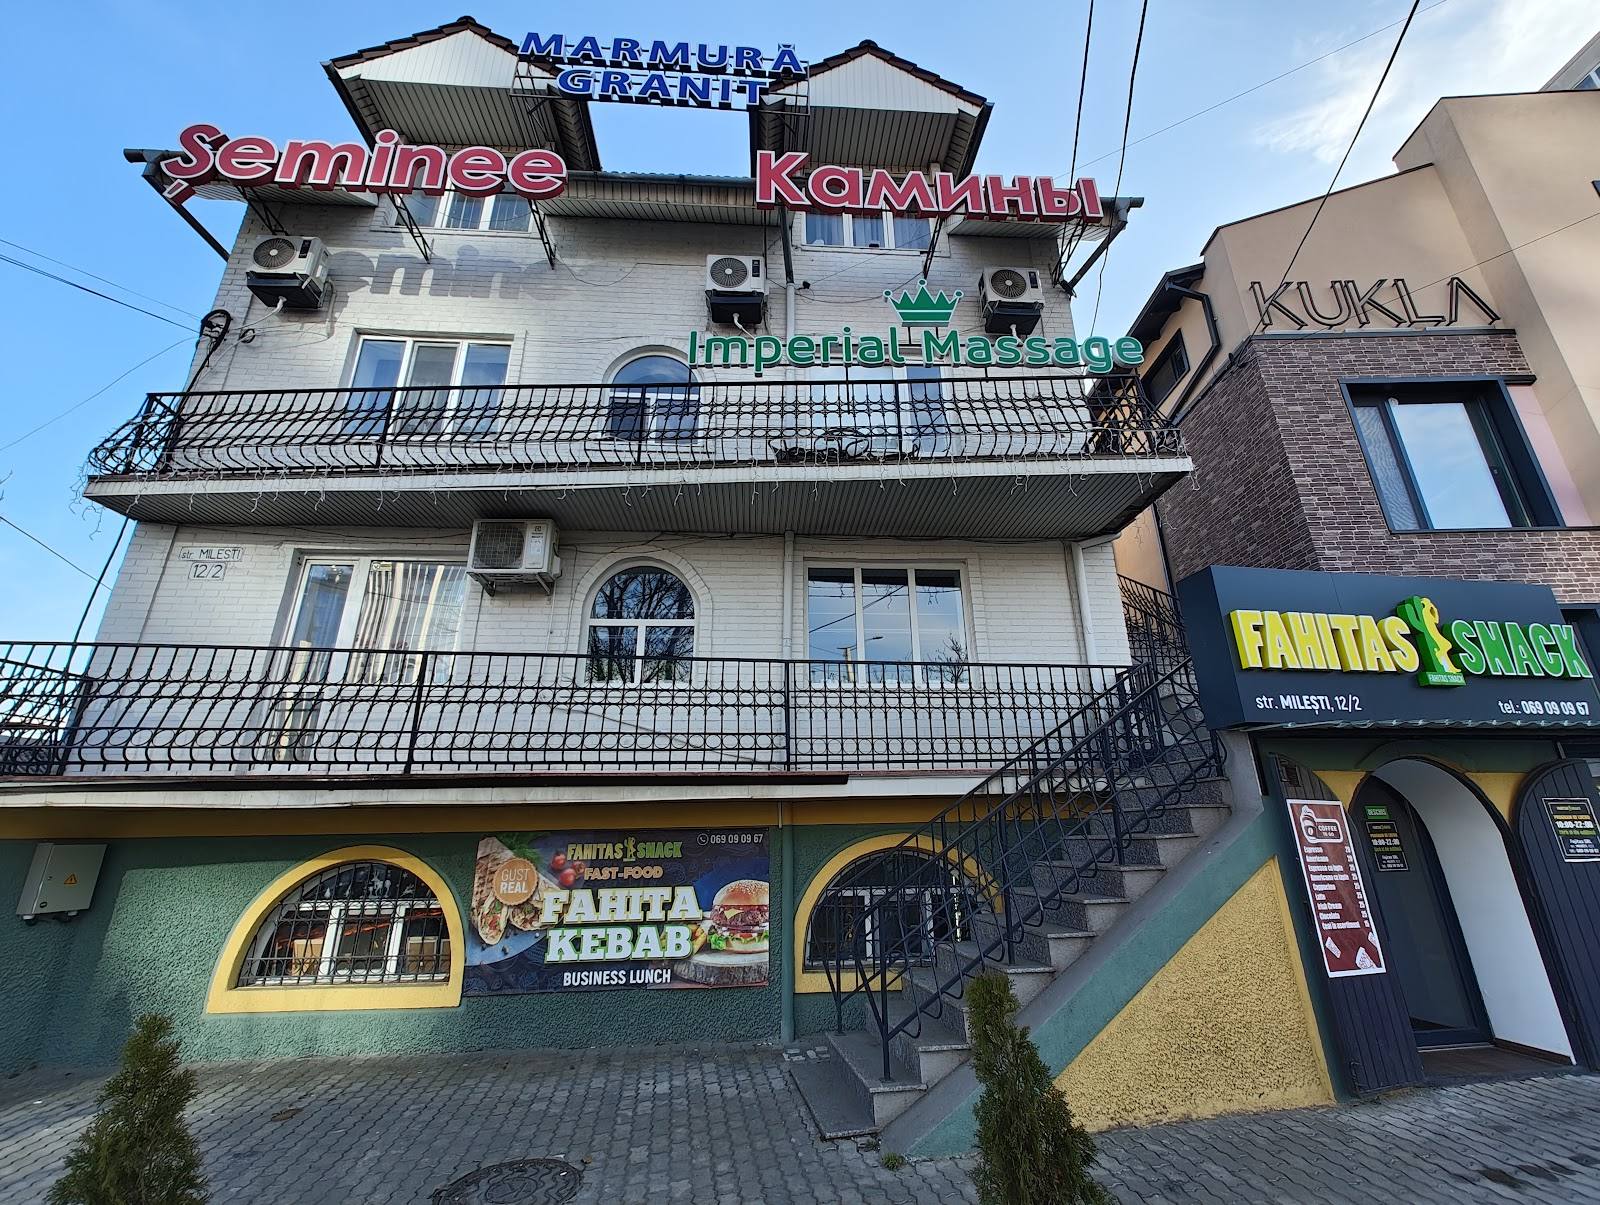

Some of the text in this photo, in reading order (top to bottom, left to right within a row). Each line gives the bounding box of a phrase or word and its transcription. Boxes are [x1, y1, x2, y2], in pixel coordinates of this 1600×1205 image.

[517, 31, 805, 75] MARMURĂ
[556, 68, 770, 105] GRANIT
[756, 150, 1104, 219] Камины
[1250, 277, 1501, 326] KUKLA
[688, 326, 1145, 376] Imperial Massage
[192, 564, 223, 578] 12/2
[1231, 609, 1594, 679] FAHITAS SNACK
[1256, 695, 1279, 709] str.
[1334, 694, 1363, 712] 12/2
[1498, 699, 1590, 716] tel.: 069 09 09 67
[710, 833, 764, 844] 069 09 09 67
[566, 841, 683, 860] FAHITAS SNACK
[501, 868, 531, 881] GUST
[583, 865, 664, 880] FAST-FOOD
[500, 881, 529, 894] REAL
[540, 886, 703, 925] FAHITA
[545, 924, 695, 963] KEBAB
[563, 969, 672, 986] BUSINESS LUNCH
